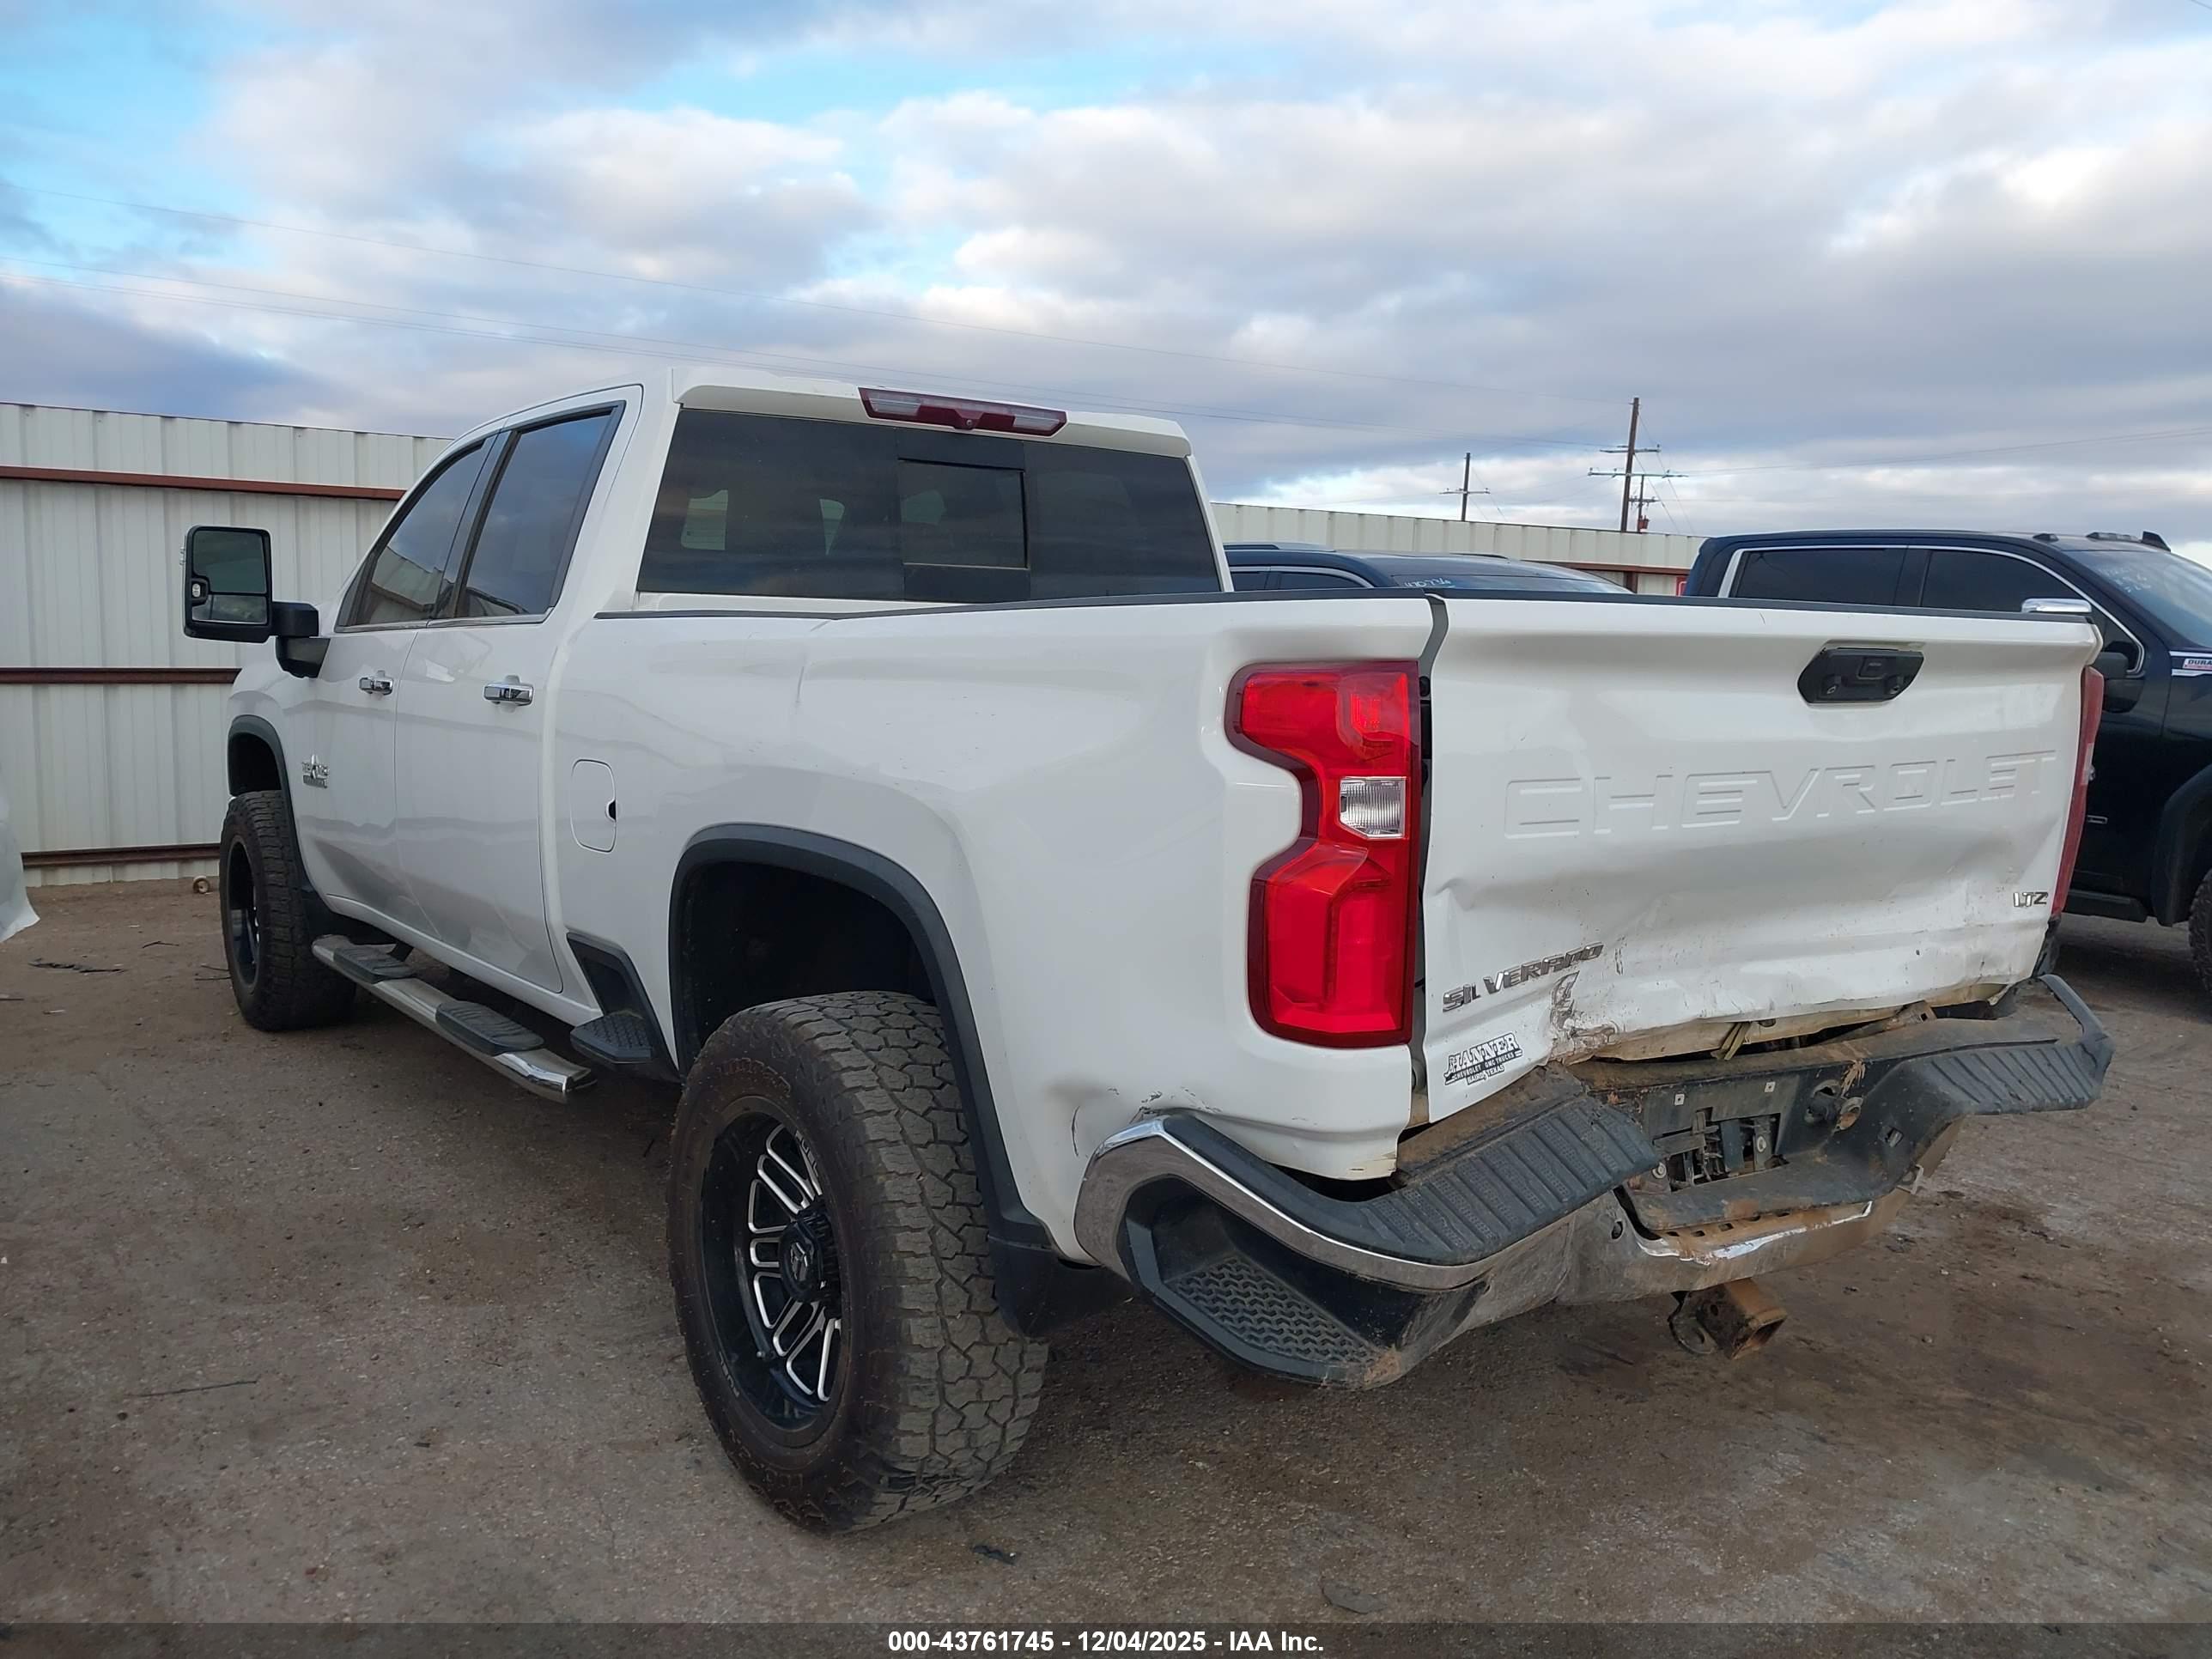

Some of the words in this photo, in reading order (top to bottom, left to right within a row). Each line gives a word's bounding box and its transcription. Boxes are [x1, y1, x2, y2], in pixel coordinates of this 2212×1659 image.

[1504, 750, 2056, 840] CHEVROLET
[2014, 891, 2049, 908] LTZ
[1442, 942, 1605, 1012] SILVERADO
[1447, 1033, 1519, 1073] HANNER
[1454, 1064, 1481, 1080] CHEVROLET
[1484, 1059, 1497, 1069] GMC
[1496, 1052, 1516, 1065] TRUCKS
[1486, 1065, 1504, 1078] TEXAS
